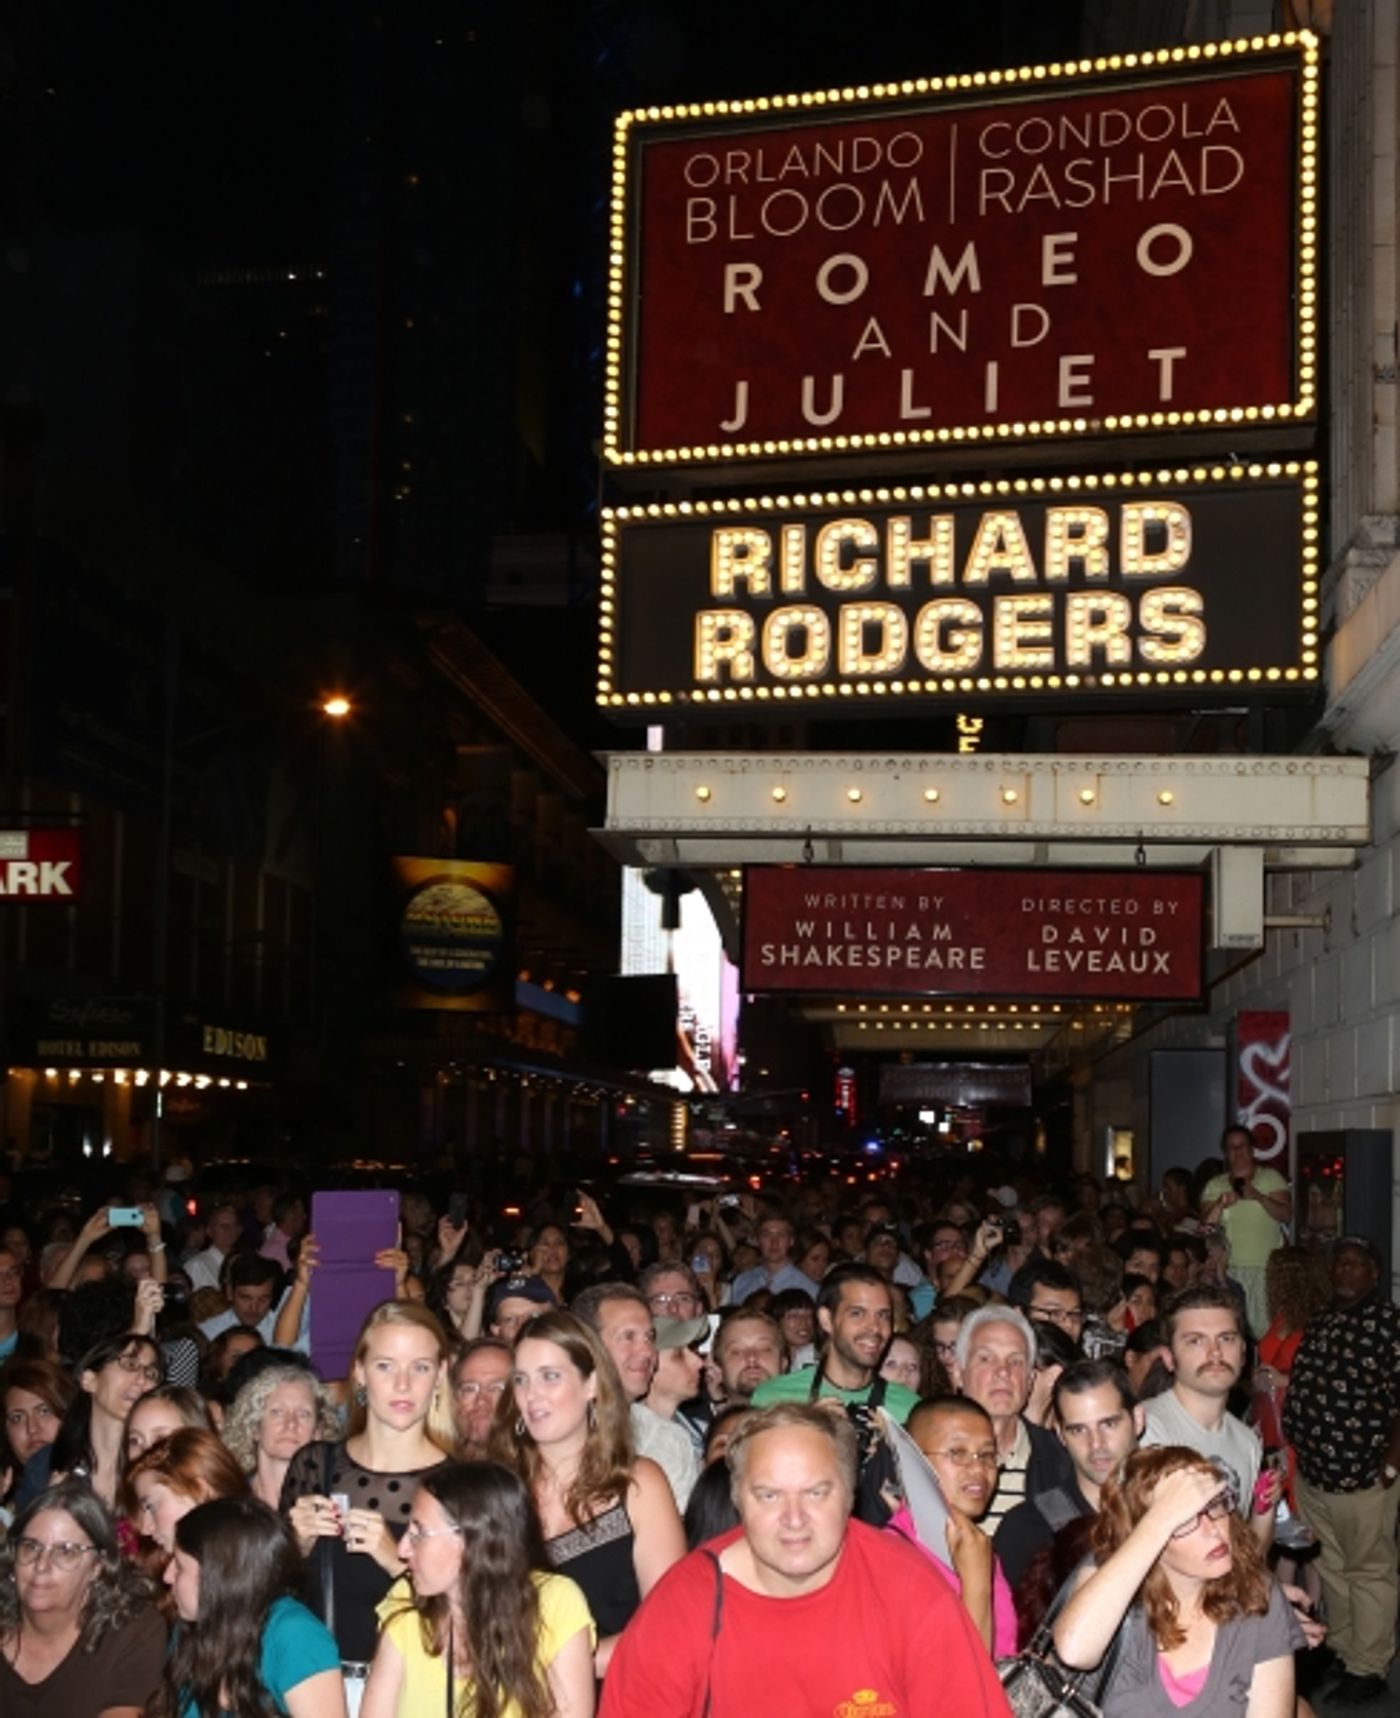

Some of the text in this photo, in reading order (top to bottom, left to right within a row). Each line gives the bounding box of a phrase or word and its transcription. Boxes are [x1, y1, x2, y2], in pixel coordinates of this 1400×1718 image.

[977, 97, 1241, 160] CONDOLA
[683, 131, 925, 189] ORLANDO
[977, 144, 1246, 217] RASHAD
[685, 176, 925, 244] BLOOM
[722, 222, 1193, 315] ROMEO
[851, 302, 1051, 361] AND
[719, 347, 1187, 434] JULIET
[709, 500, 1194, 599] RICHARD
[693, 585, 1207, 684] RODGERS
[0, 861, 73, 895] RK
[804, 894, 945, 911] WRITTEN BY
[1021, 898, 1179, 916] DIRECTED BY
[760, 944, 986, 971] SHAKESPEARE
[795, 920, 954, 942] WILLIAM
[1041, 926, 1157, 947] DAVID
[1027, 950, 1171, 975] LEVEAUX
[203, 1025, 268, 1062] EDISON
